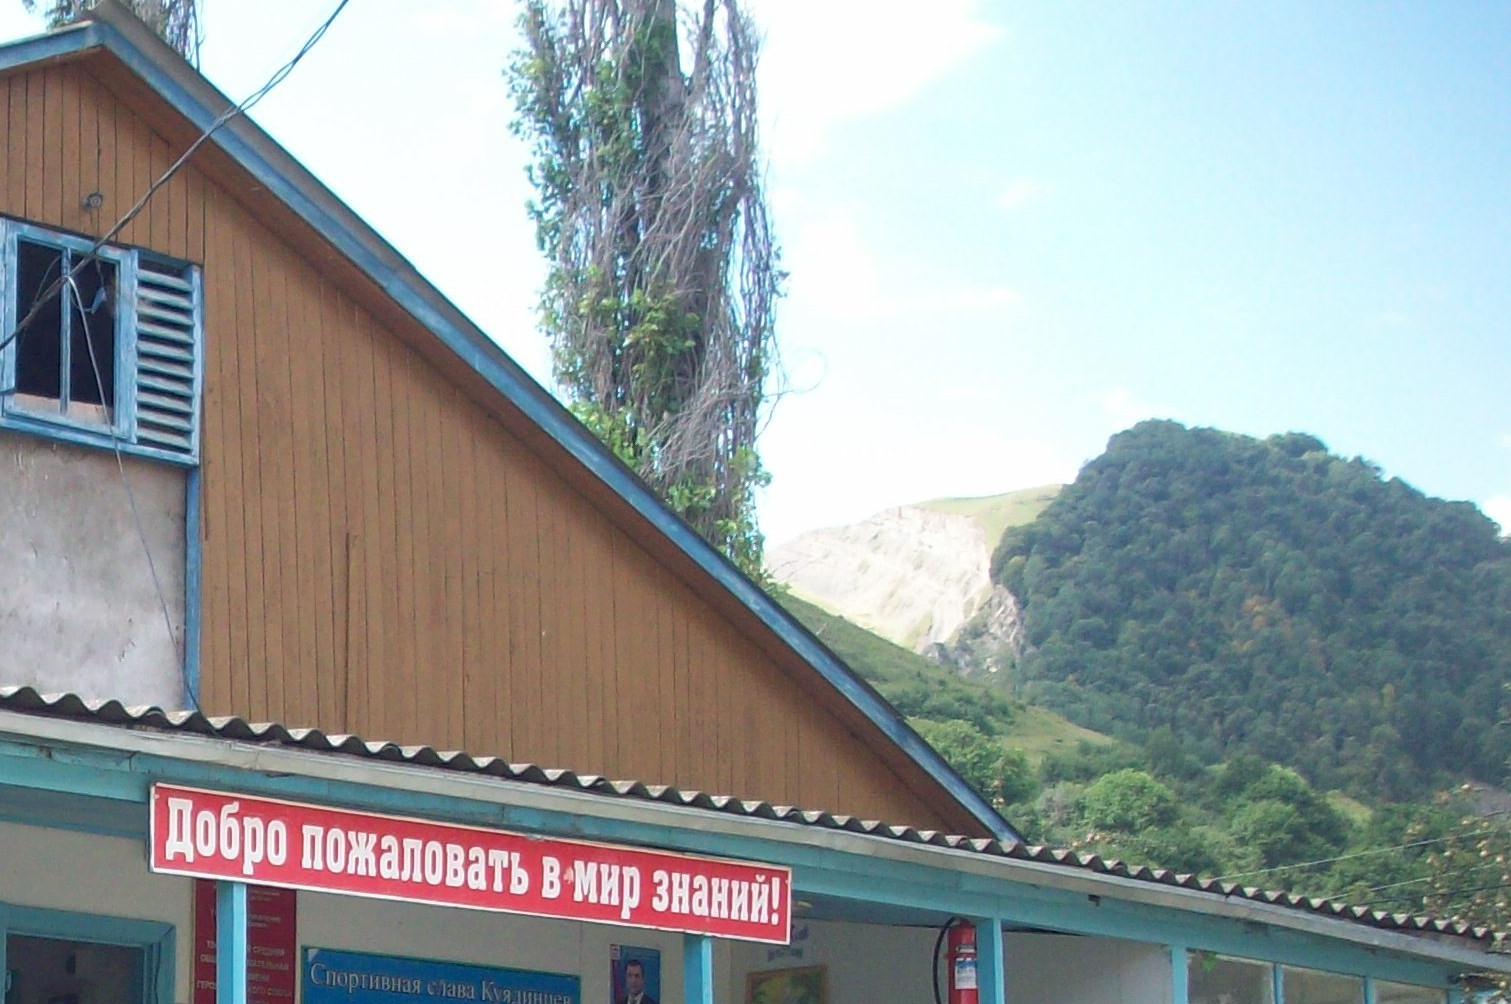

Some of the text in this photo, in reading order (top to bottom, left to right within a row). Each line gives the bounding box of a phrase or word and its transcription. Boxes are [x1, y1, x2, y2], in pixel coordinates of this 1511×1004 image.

[165, 797, 780, 925] Добро пожаловать в мир знаний!
[310, 963, 421, 995] Спортивная
[427, 981, 475, 999] слава
